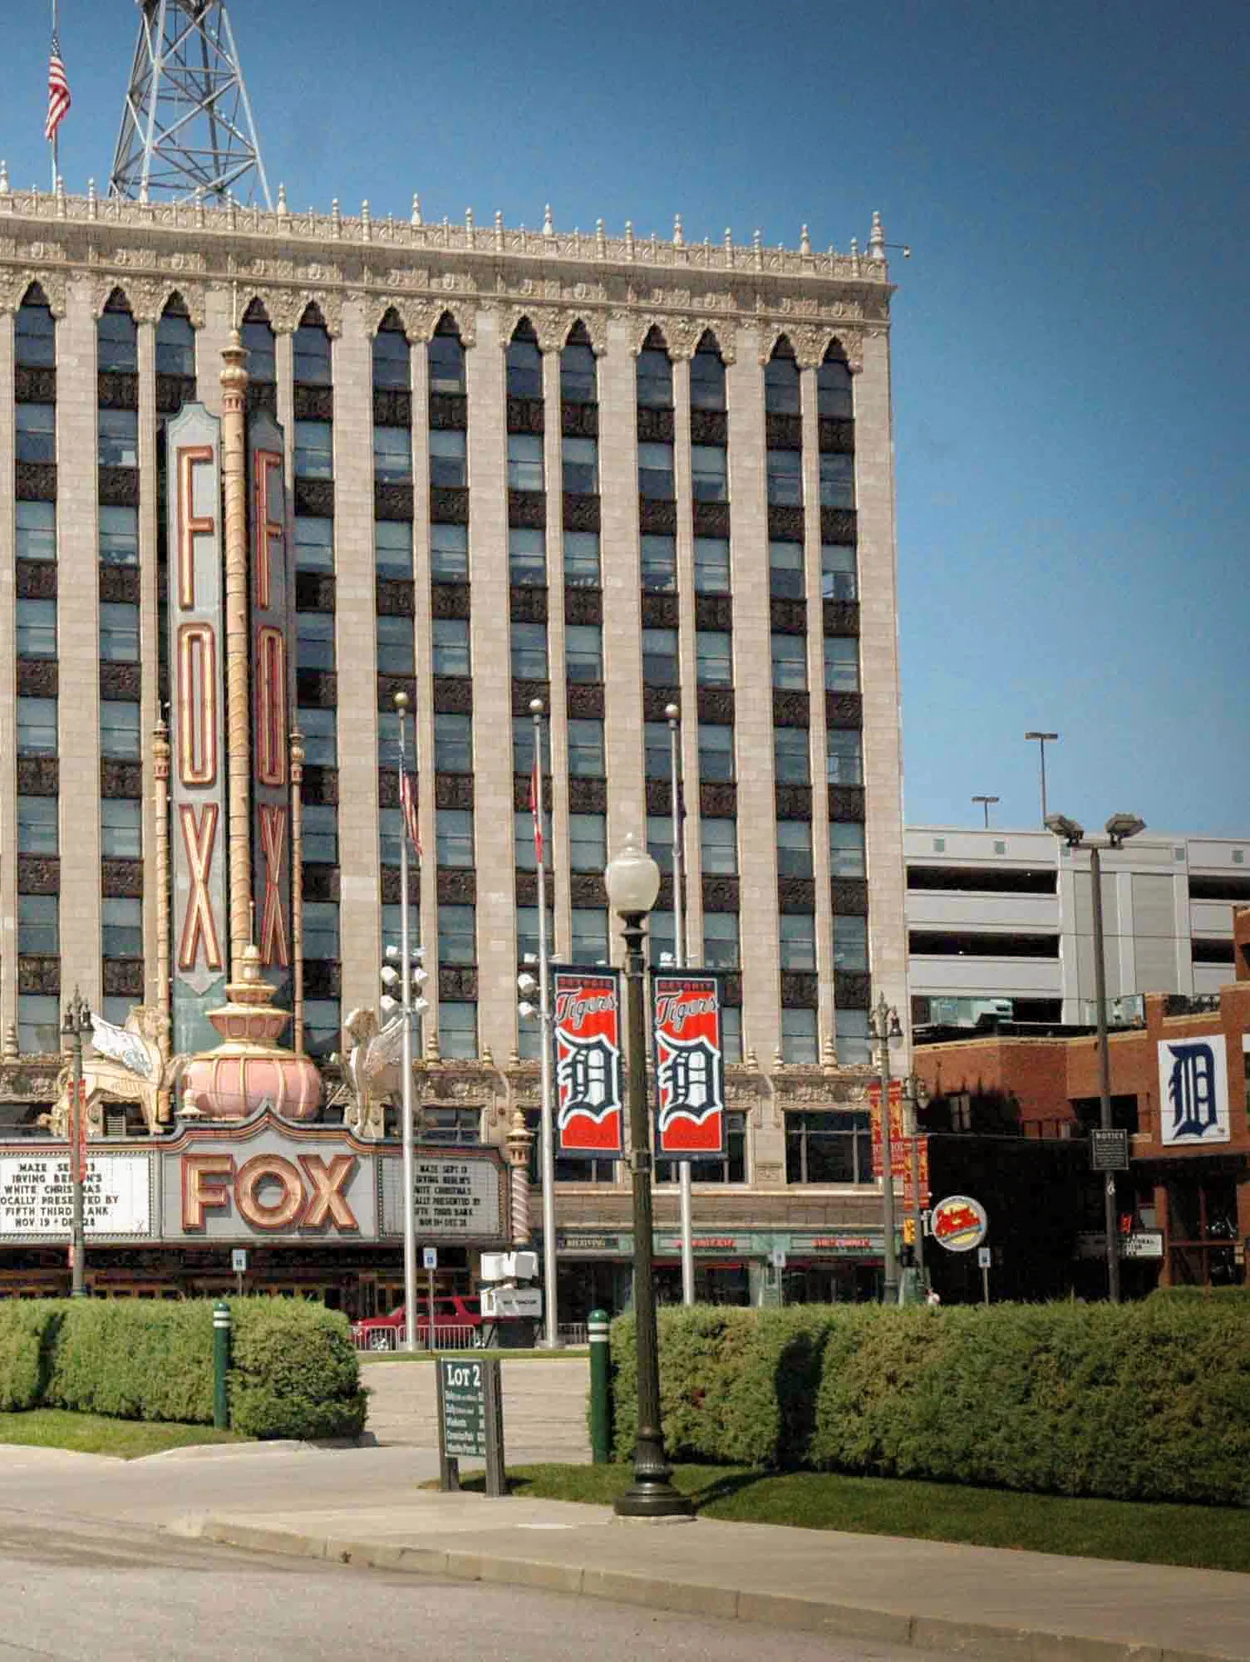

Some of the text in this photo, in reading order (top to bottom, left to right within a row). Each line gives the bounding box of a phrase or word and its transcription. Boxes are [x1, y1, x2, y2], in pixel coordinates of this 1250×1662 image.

[176, 444, 222, 971] FOX
[255, 448, 288, 968] FOX
[554, 986, 618, 1029] Tigers
[654, 990, 719, 1033] Tigers
[19, 1163, 47, 1172] MAZE
[12, 1174, 46, 1183] IRVING
[4, 1185, 101, 1194] WHITE CHRISMAS
[181, 1153, 361, 1232] FOX
[41, 1196, 101, 1205] PRESETED
[105, 1195, 119, 1204] BY
[5, 1207, 35, 1216] FIFTH
[40, 1207, 72, 1216] THIRD
[15, 1218, 35, 1227] NOV
[40, 1218, 50, 1226] 19
[472, 1365, 481, 1387] 2
